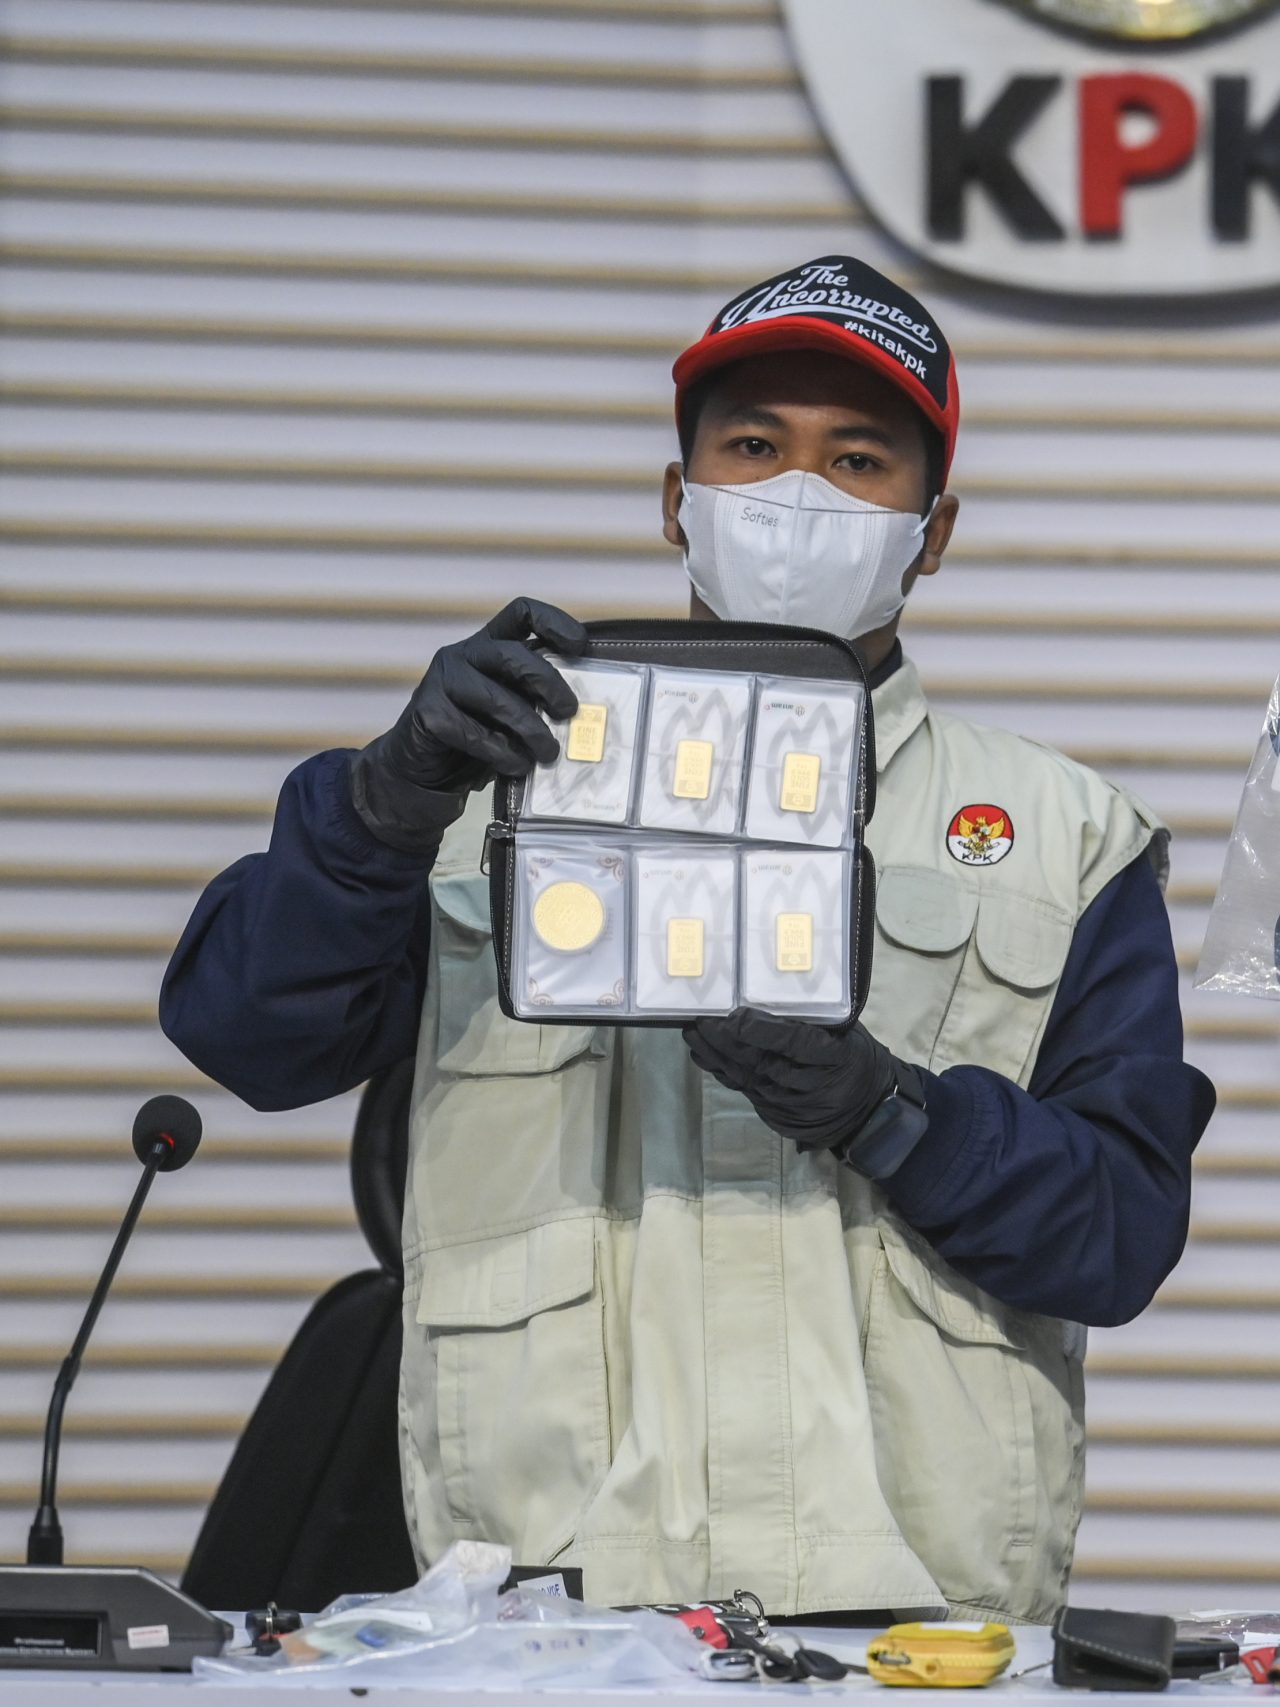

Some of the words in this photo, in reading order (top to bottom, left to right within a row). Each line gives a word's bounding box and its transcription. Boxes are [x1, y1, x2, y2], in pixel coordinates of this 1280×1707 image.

[788, 264, 848, 291] The
[719, 279, 937, 353] Uncorrupted
[844, 320, 928, 379] #kitakpk
[962, 852, 994, 862] KPK
